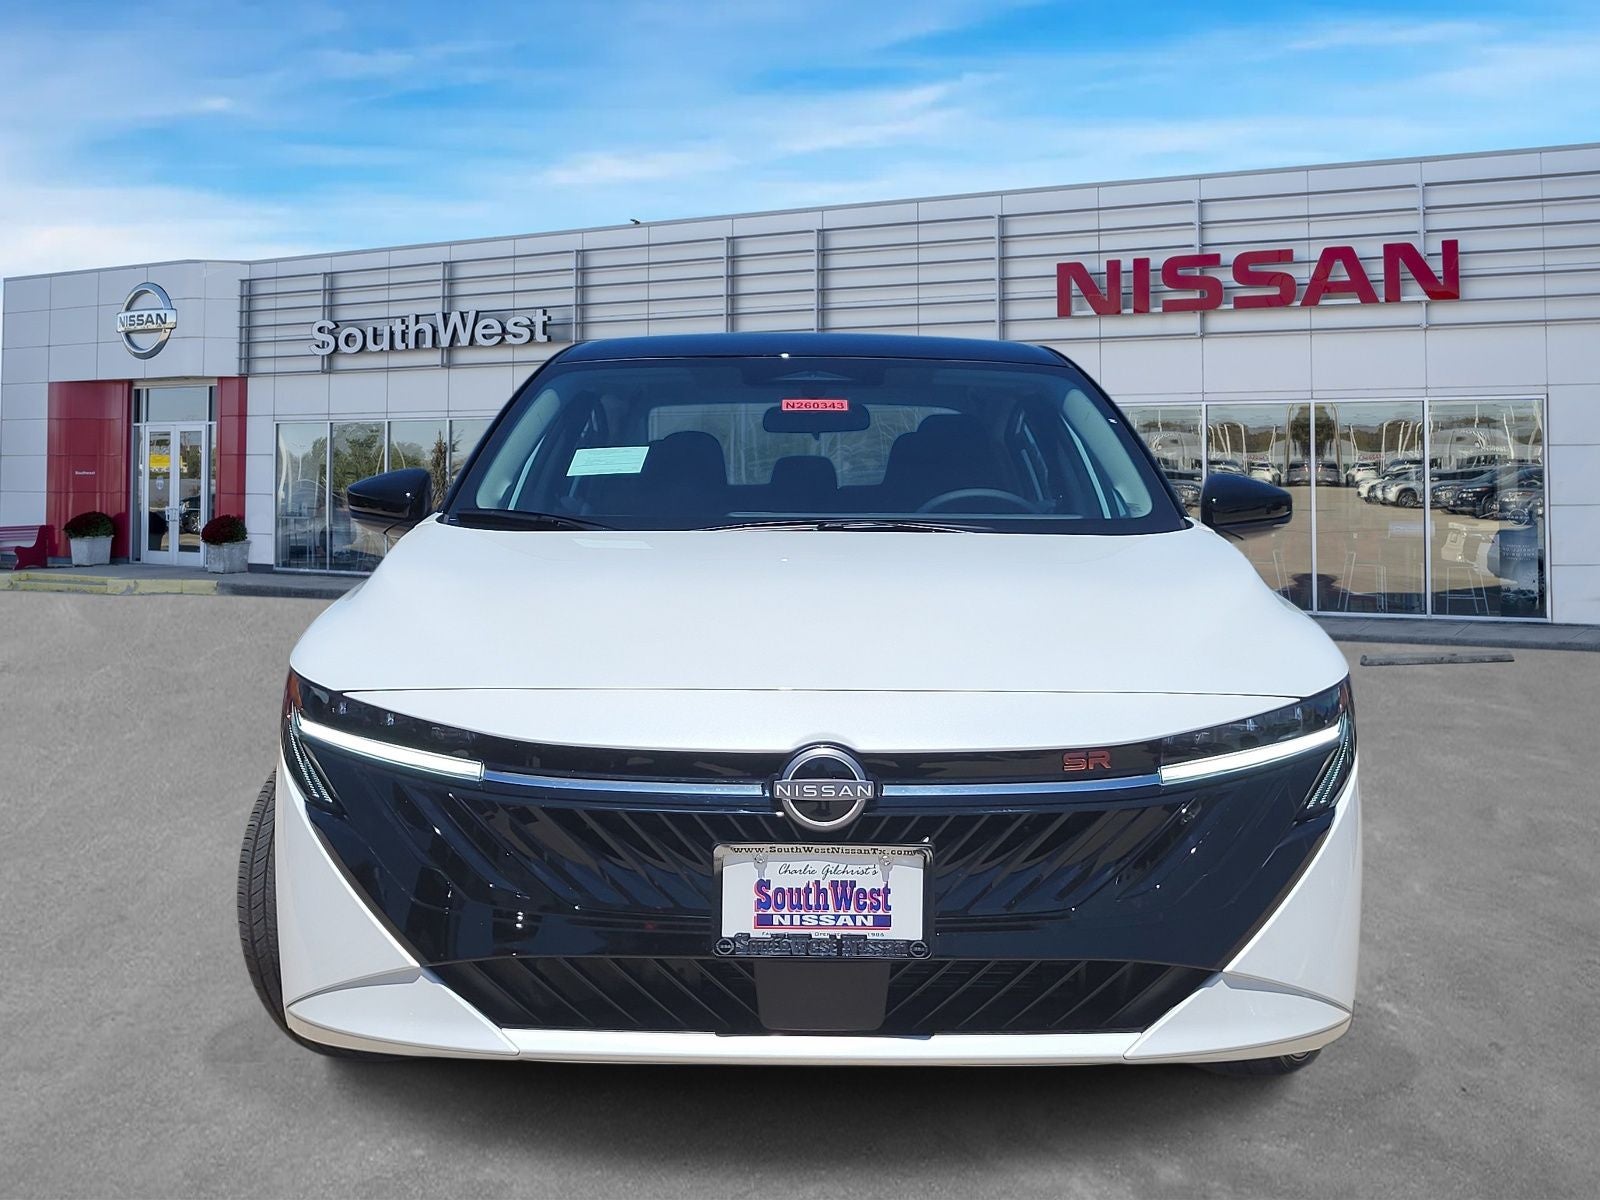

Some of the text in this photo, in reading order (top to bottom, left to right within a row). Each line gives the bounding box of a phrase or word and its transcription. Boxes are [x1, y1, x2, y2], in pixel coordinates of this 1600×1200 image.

[1057, 239, 1460, 318] NISSAN
[118, 312, 168, 328] NISSAN
[309, 308, 550, 356] SouthWest
[785, 401, 845, 410] N260343
[1063, 750, 1112, 771] SR
[775, 783, 873, 798] NISSAN
[732, 846, 914, 857] www.SouthWestNissanTx.com
[778, 863, 879, 881] Charlie Gilchrist's
[754, 878, 892, 913] SouthWest
[772, 914, 874, 927] NISSAN
